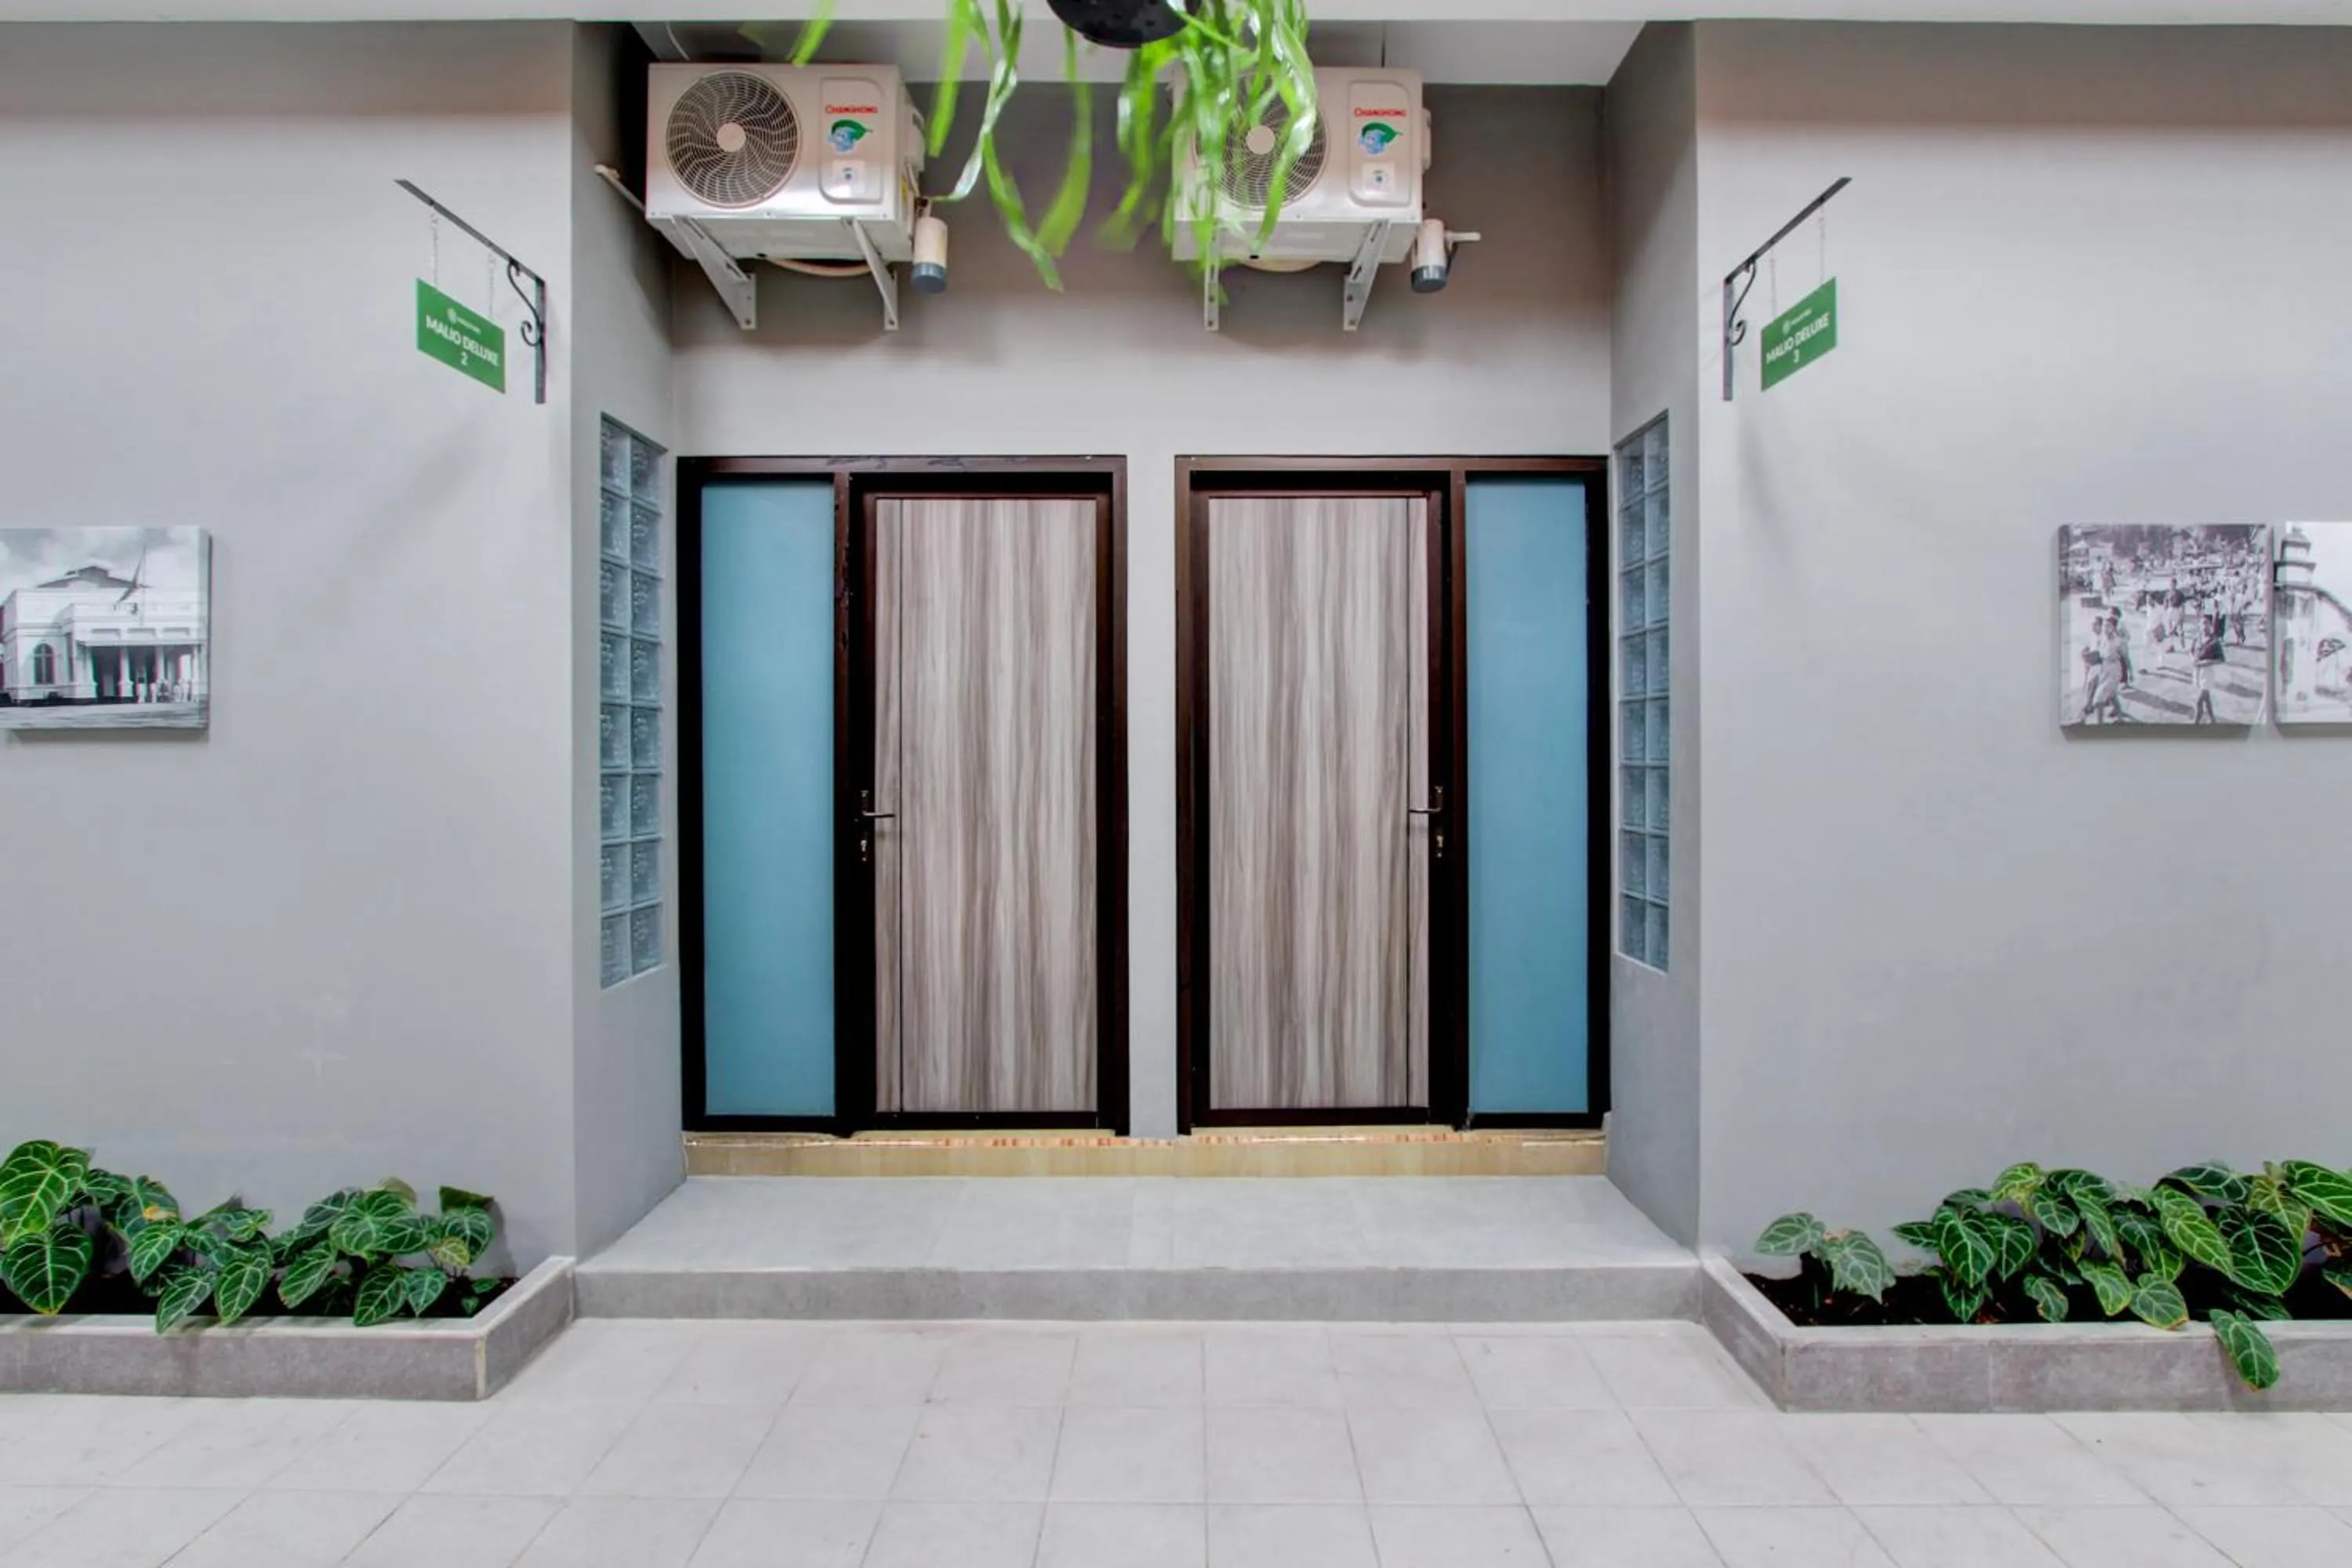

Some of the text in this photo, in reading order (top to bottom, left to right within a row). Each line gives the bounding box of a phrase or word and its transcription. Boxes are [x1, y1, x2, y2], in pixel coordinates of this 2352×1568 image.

[426, 314, 461, 346] MALIO
[463, 336, 499, 367] DELUXE
[460, 352, 469, 366] 2
[1766, 336, 1794, 365] MALIO
[1795, 312, 1831, 346] DELUXE
